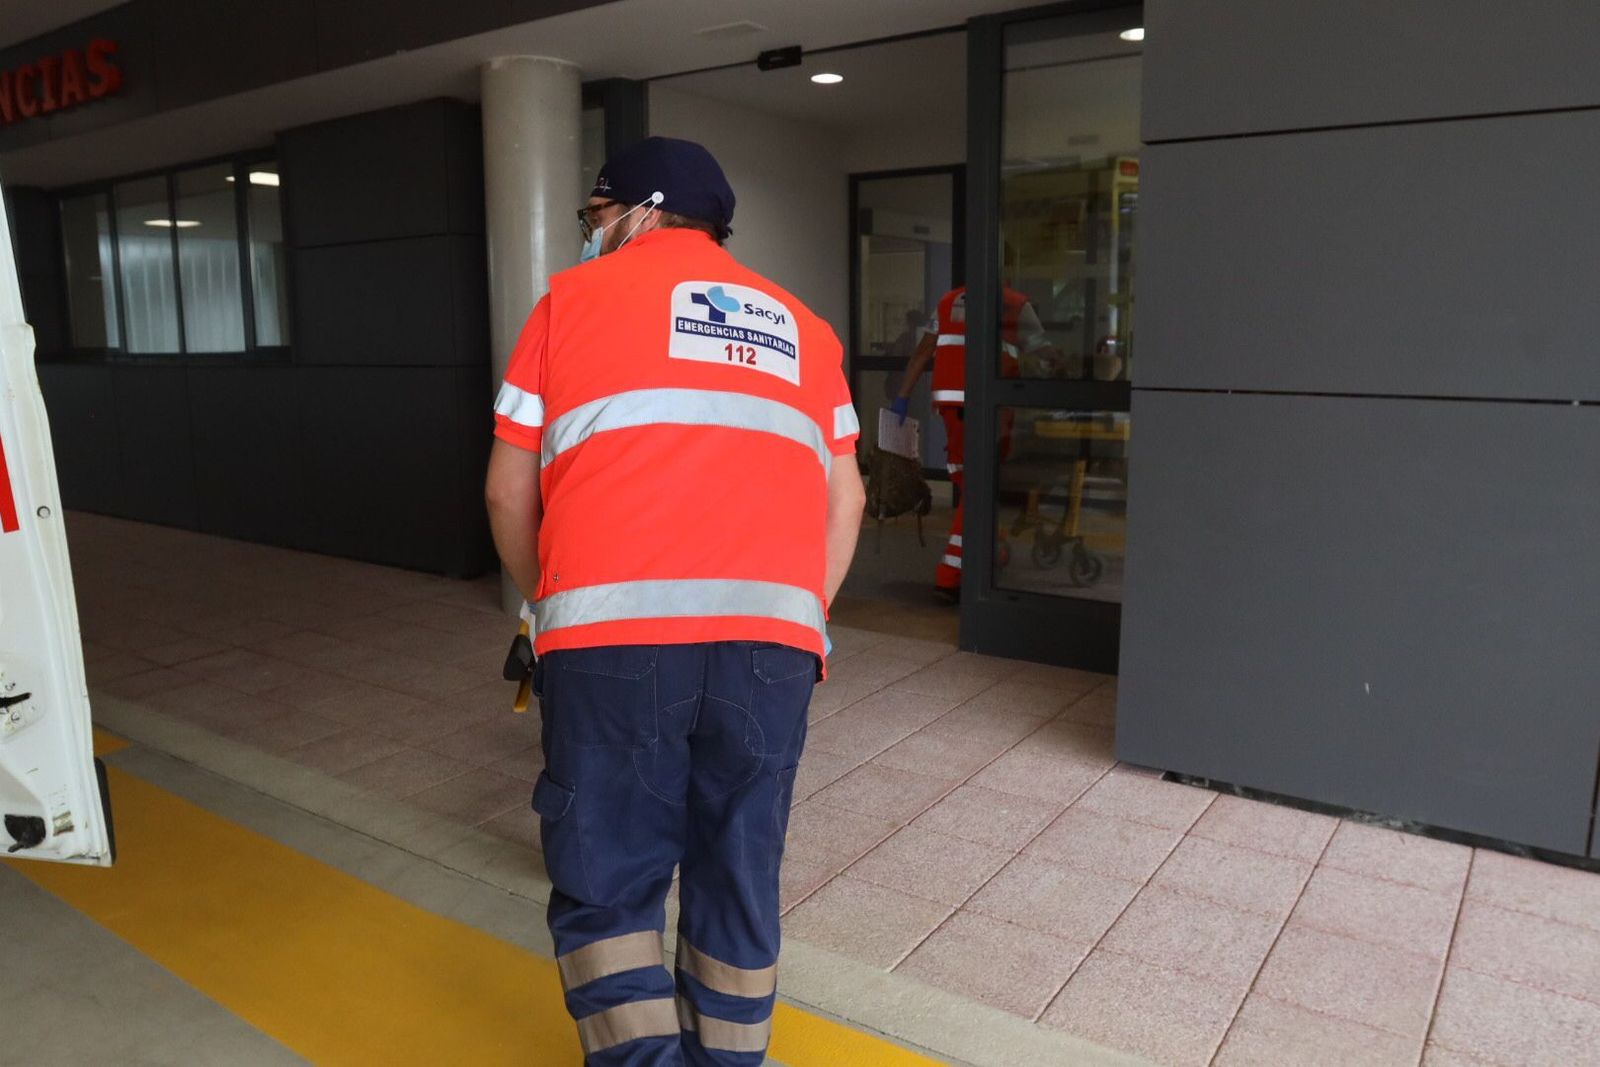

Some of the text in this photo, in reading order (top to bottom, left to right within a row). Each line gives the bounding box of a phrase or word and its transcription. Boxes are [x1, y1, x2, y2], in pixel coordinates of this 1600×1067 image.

[744, 303, 786, 325] Sacyl
[677, 320, 795, 356] EMERGENCIAS SANITARIAS
[724, 343, 756, 365] 112
